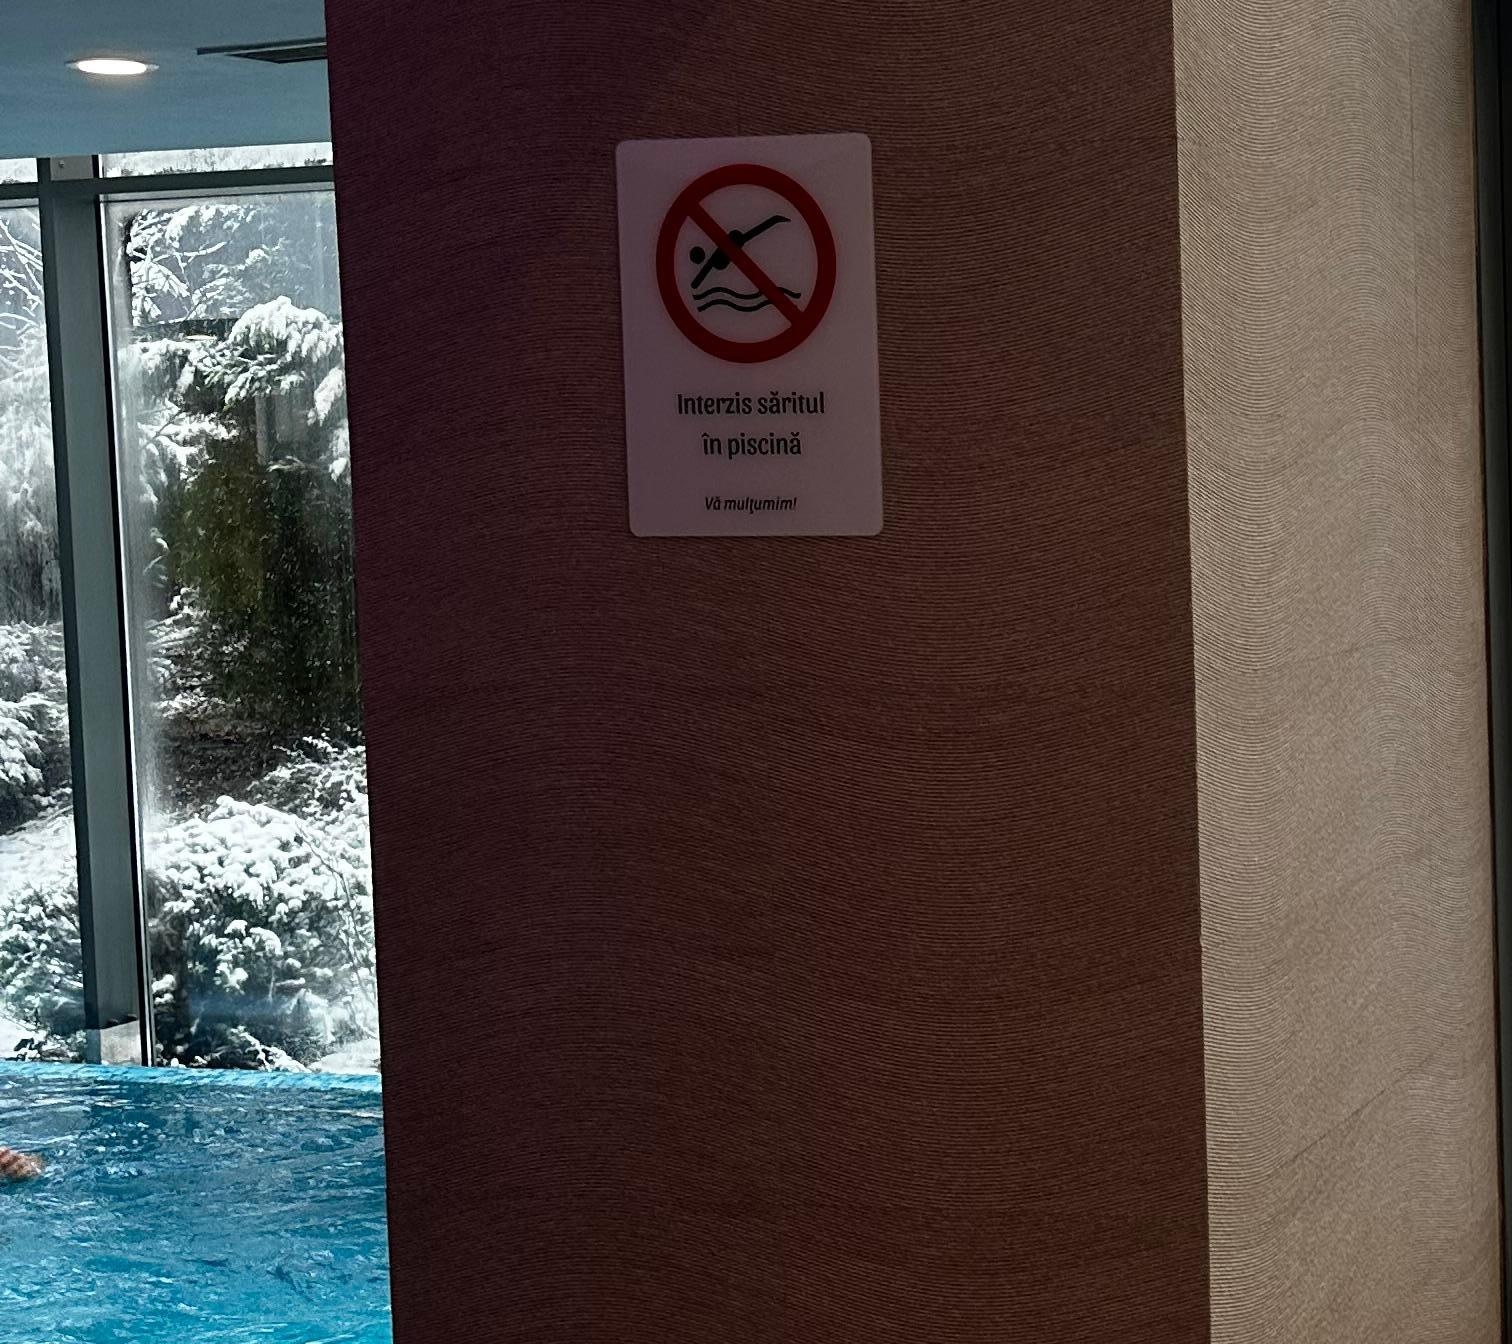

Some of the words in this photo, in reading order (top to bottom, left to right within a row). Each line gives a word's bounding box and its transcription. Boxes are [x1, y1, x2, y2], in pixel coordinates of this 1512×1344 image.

[677, 392, 752, 415] Interzis
[757, 391, 825, 414] săritul
[701, 432, 722, 455] în
[727, 431, 802, 460] piscină
[705, 496, 721, 511] Vă
